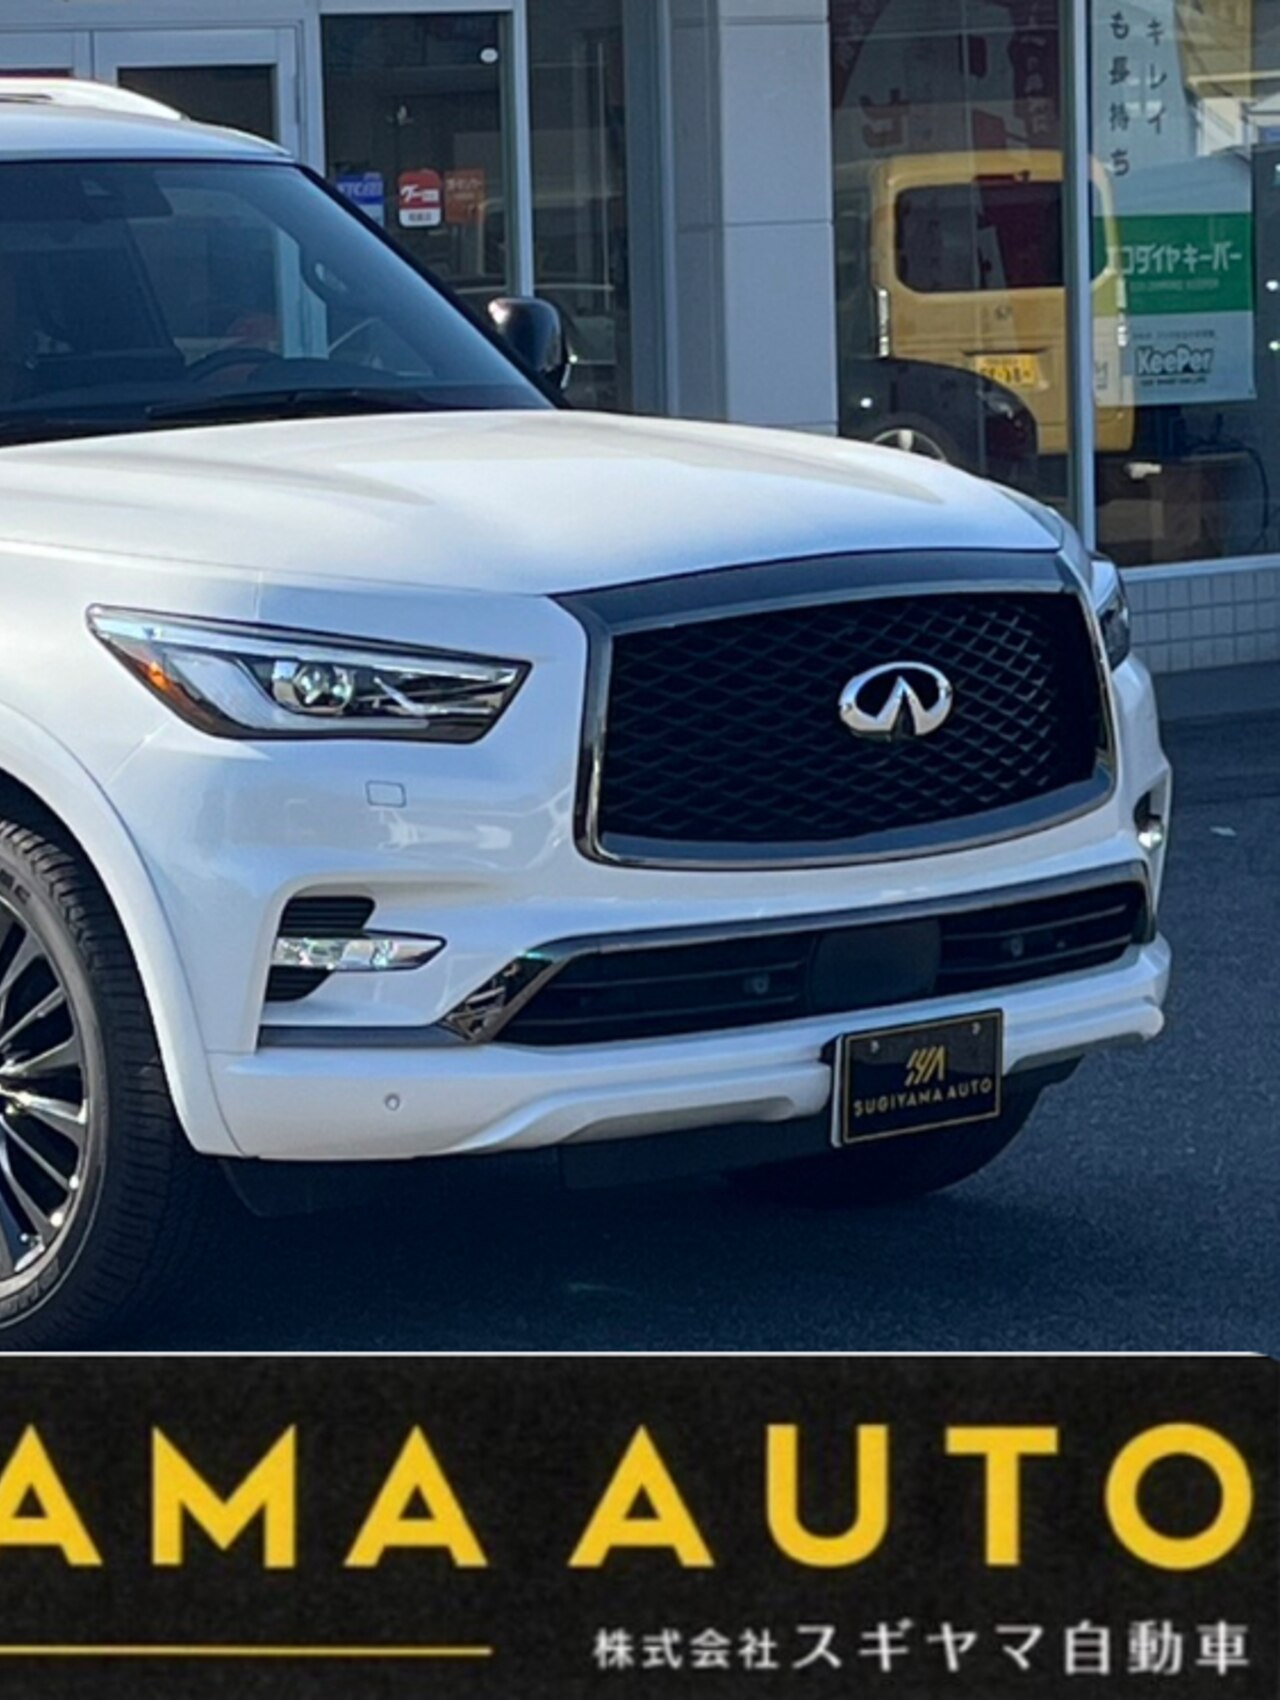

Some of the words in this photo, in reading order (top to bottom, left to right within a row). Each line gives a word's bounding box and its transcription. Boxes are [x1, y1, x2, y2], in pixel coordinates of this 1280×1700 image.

[1109, 11, 1130, 177] も長持ち
[1147, 18, 1167, 135] キレイ
[1136, 343, 1214, 377] KeePer
[852, 1087, 943, 1118] SUGIYAMA
[946, 1077, 993, 1099] AUTO
